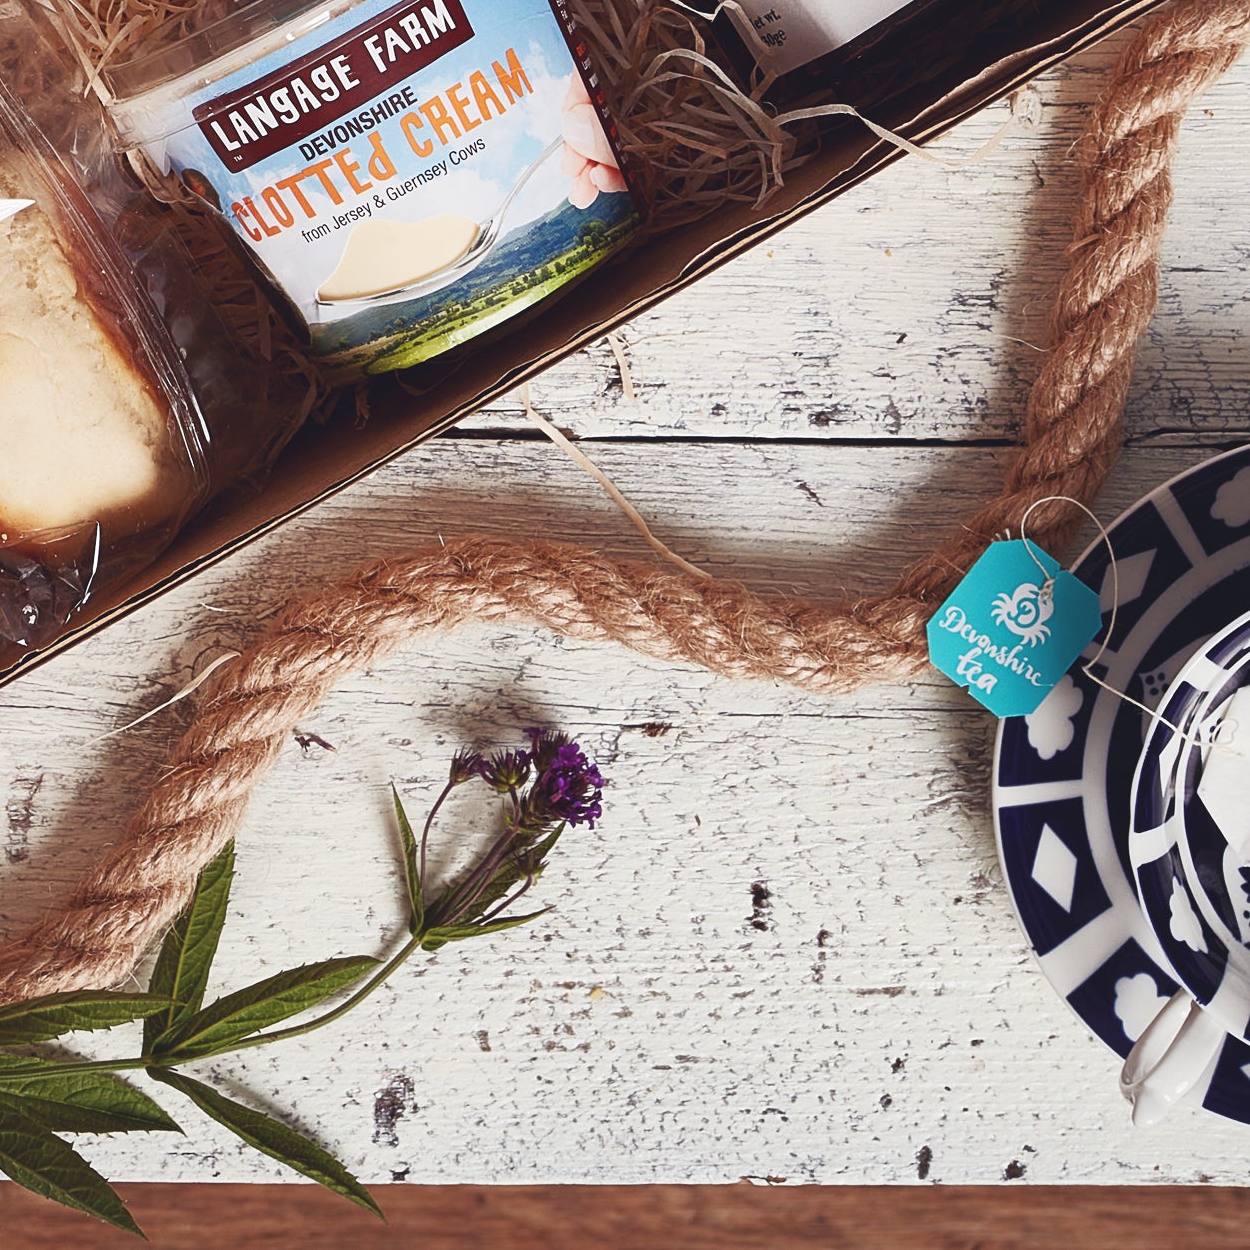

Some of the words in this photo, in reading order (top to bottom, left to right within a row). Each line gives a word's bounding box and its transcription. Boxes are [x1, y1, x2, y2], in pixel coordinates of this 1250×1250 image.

[210, 54, 361, 152] LANGAGE
[298, 85, 418, 162] DEVONSHIRE
[397, 48, 535, 157] CREAM
[300, 222, 331, 245] from
[329, 202, 372, 230] Jersey
[372, 193, 386, 208] &
[384, 159, 450, 200] Guernsey
[448, 136, 486, 165] Cows
[939, 606, 1052, 687] Devonshire
[957, 648, 998, 695] tea
